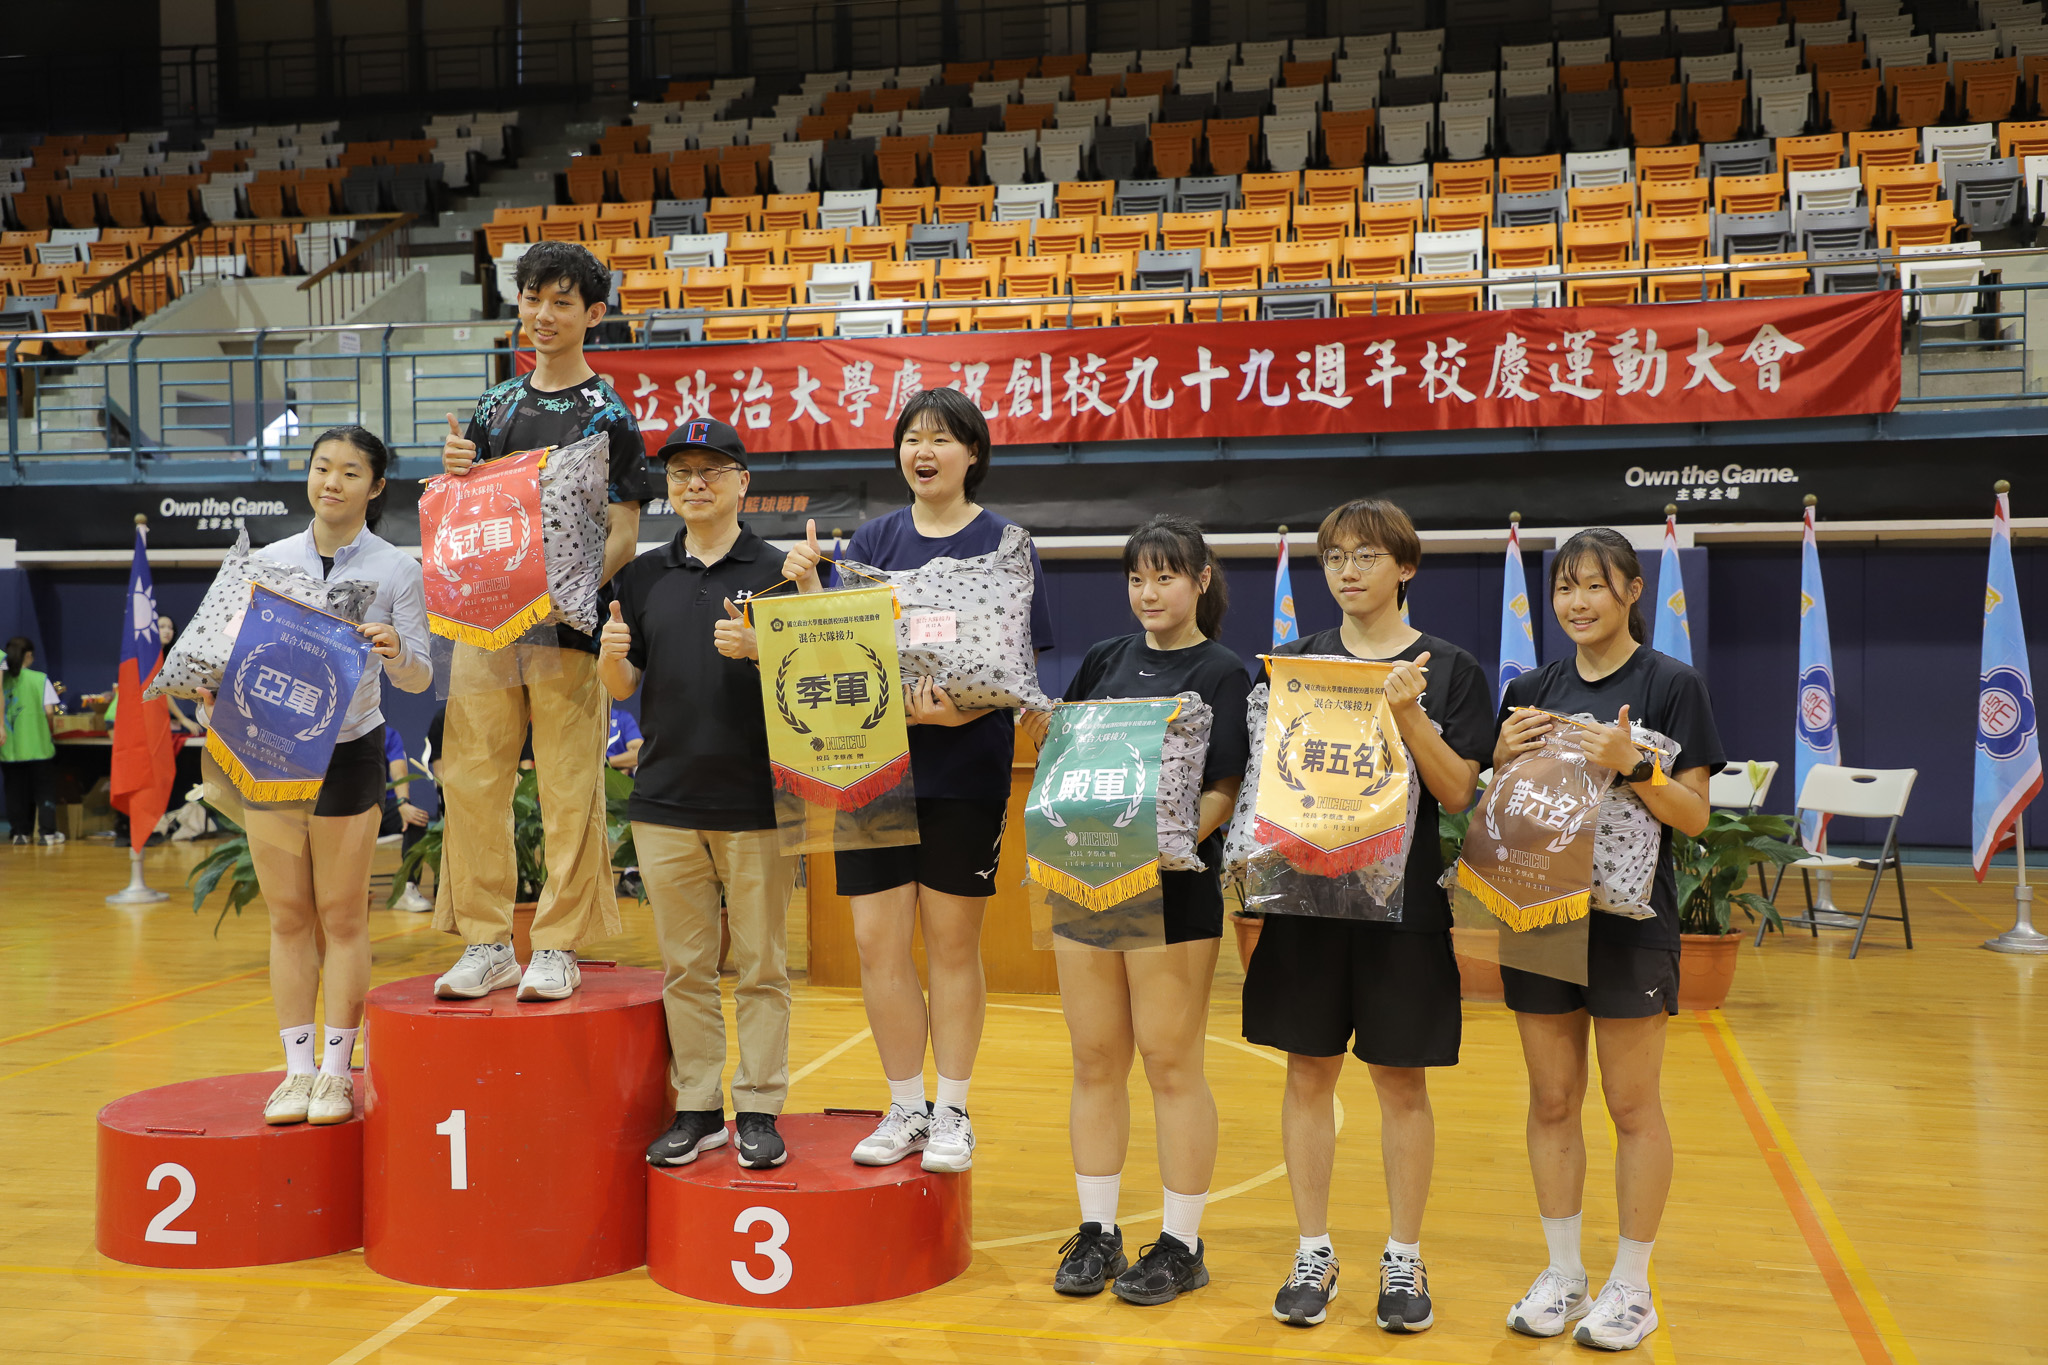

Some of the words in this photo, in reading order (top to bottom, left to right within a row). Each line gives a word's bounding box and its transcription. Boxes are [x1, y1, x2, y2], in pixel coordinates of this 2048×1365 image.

[602, 323, 1805, 432] 立政治大學慶祝創校九十九週年校慶運動大會
[1625, 467, 1679, 487] Own
[1681, 465, 1720, 485] the
[1722, 464, 1799, 485] Game.
[1676, 487, 1740, 501] 主宰全場
[160, 498, 201, 517] Own
[201, 498, 230, 516] the
[231, 497, 288, 516] Game.
[450, 516, 514, 561] 冠軍
[280, 632, 327, 659] 混合大隊接力
[799, 630, 854, 643] 混合大隊接力
[250, 664, 323, 718] 亞軍
[796, 671, 871, 710] 季軍
[1314, 698, 1372, 712] 混合大隊接力
[1301, 738, 1375, 779] 第五名
[1057, 767, 1129, 802] 殿軍
[1504, 778, 1579, 829] 第六名
[436, 1109, 468, 1190] 1
[144, 1162, 198, 1246] 2
[730, 1206, 794, 1296] 3
